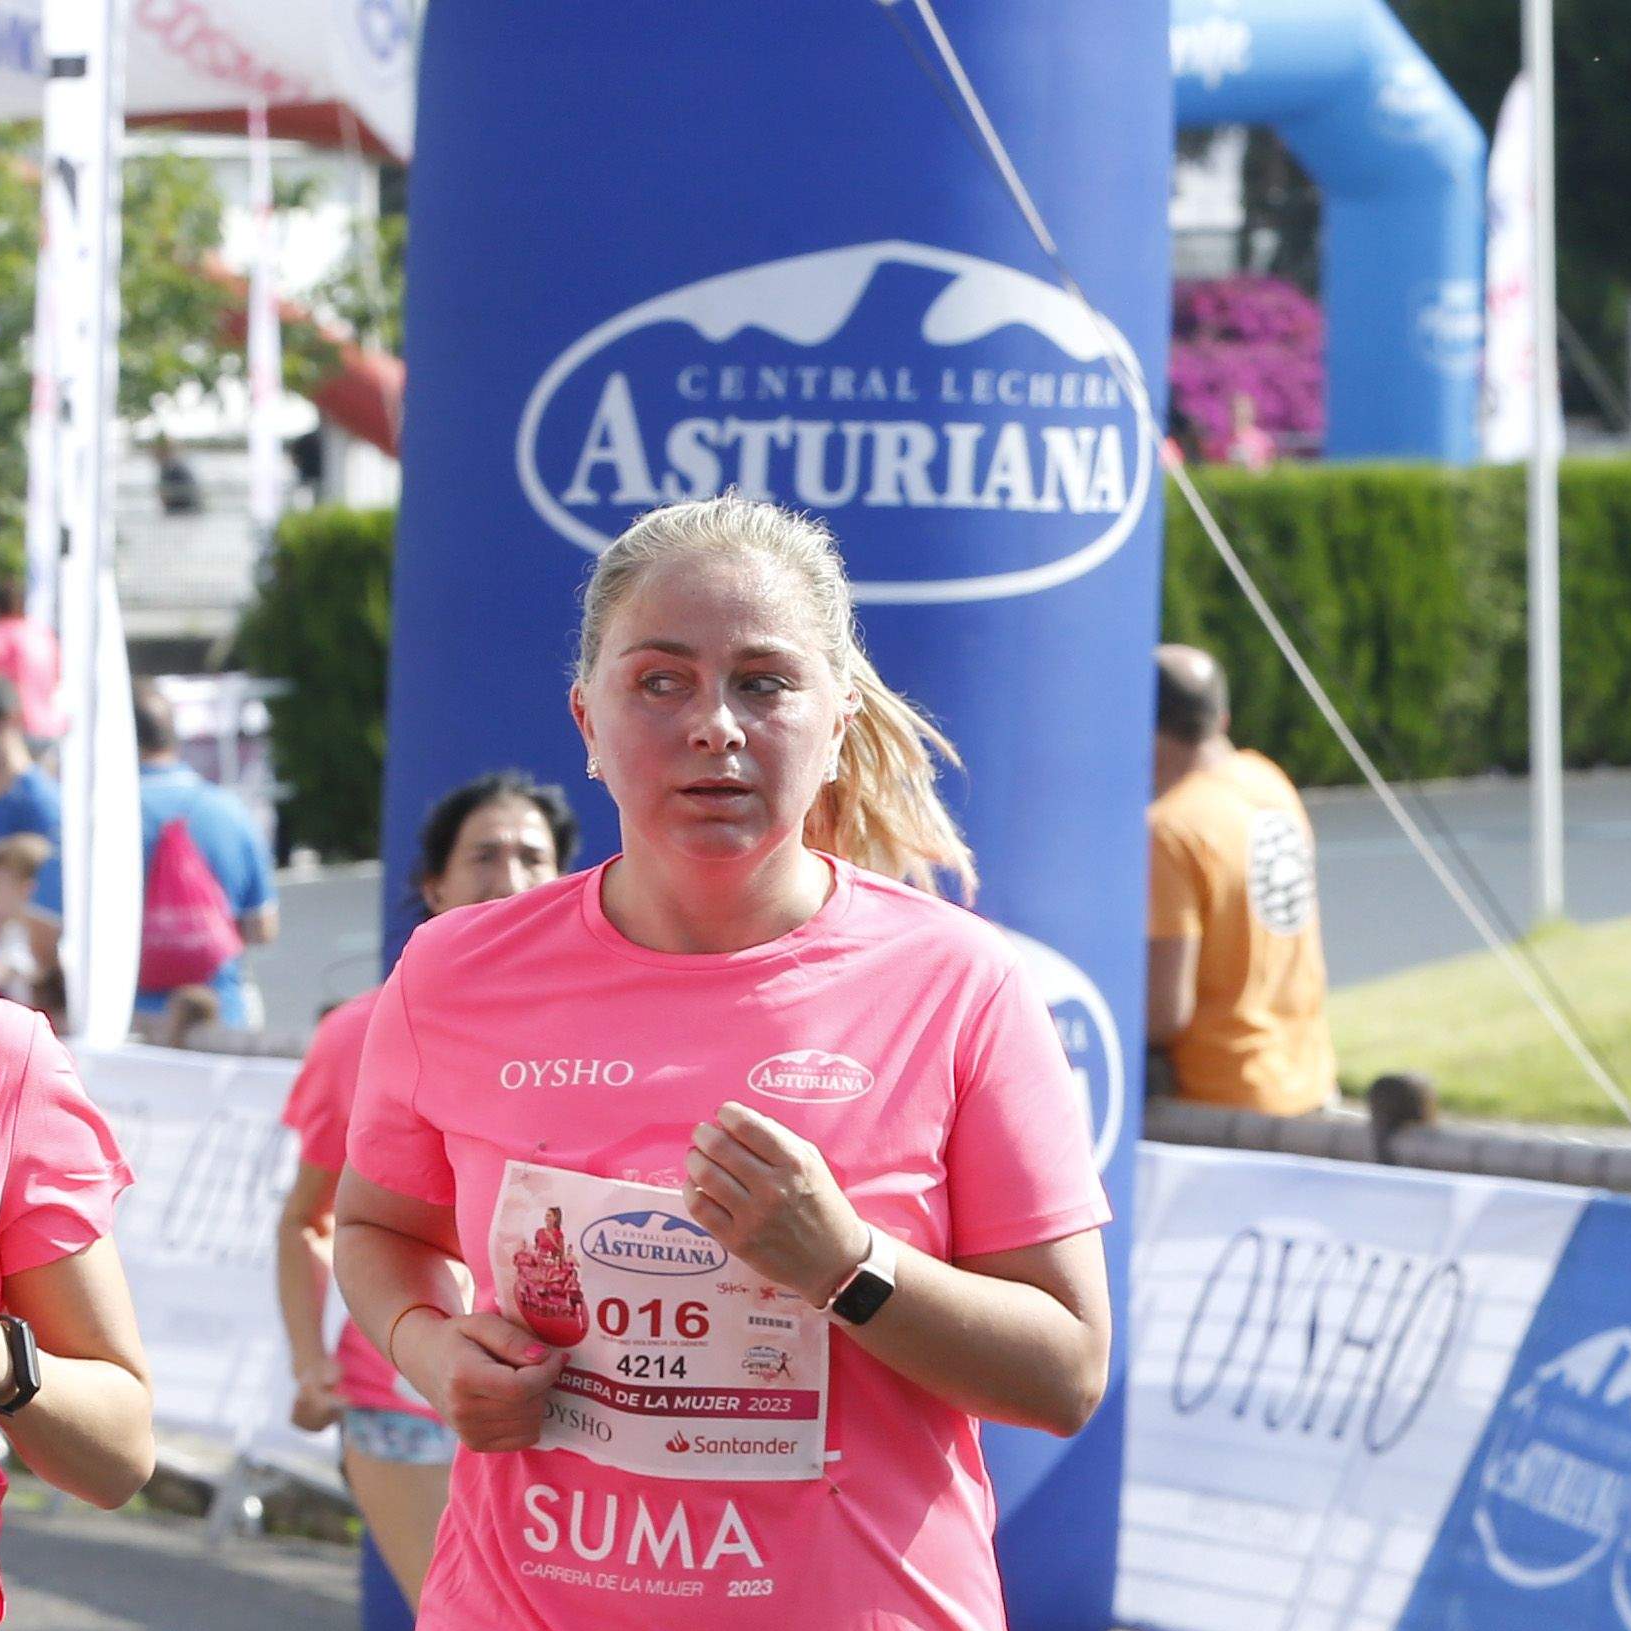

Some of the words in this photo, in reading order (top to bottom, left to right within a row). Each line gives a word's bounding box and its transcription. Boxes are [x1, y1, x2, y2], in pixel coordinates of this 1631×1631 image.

[677, 364, 919, 401] CENTRAL
[562, 372, 1125, 514] ASTURIANA
[499, 1058, 635, 1091] OYSHO
[755, 1070, 865, 1092] ASTURIANA
[591, 1229, 716, 1266] ASTURIANA
[597, 1297, 709, 1339] 016
[1170, 1227, 1469, 1457] OYSHO
[616, 1354, 687, 1379] 4214
[556, 1373, 612, 1400] RRERA
[615, 1390, 640, 1407] DE
[644, 1394, 669, 1409] LA
[673, 1395, 741, 1412] MUJER
[748, 1397, 793, 1413] 2023
[694, 1435, 798, 1455] Santander
[523, 1483, 765, 1571] SUMA
[520, 1560, 593, 1587] CARRERA
[595, 1573, 618, 1590] DE
[620, 1576, 642, 1594] LA
[644, 1579, 703, 1597] MUJER
[727, 1578, 774, 1598] 2023
